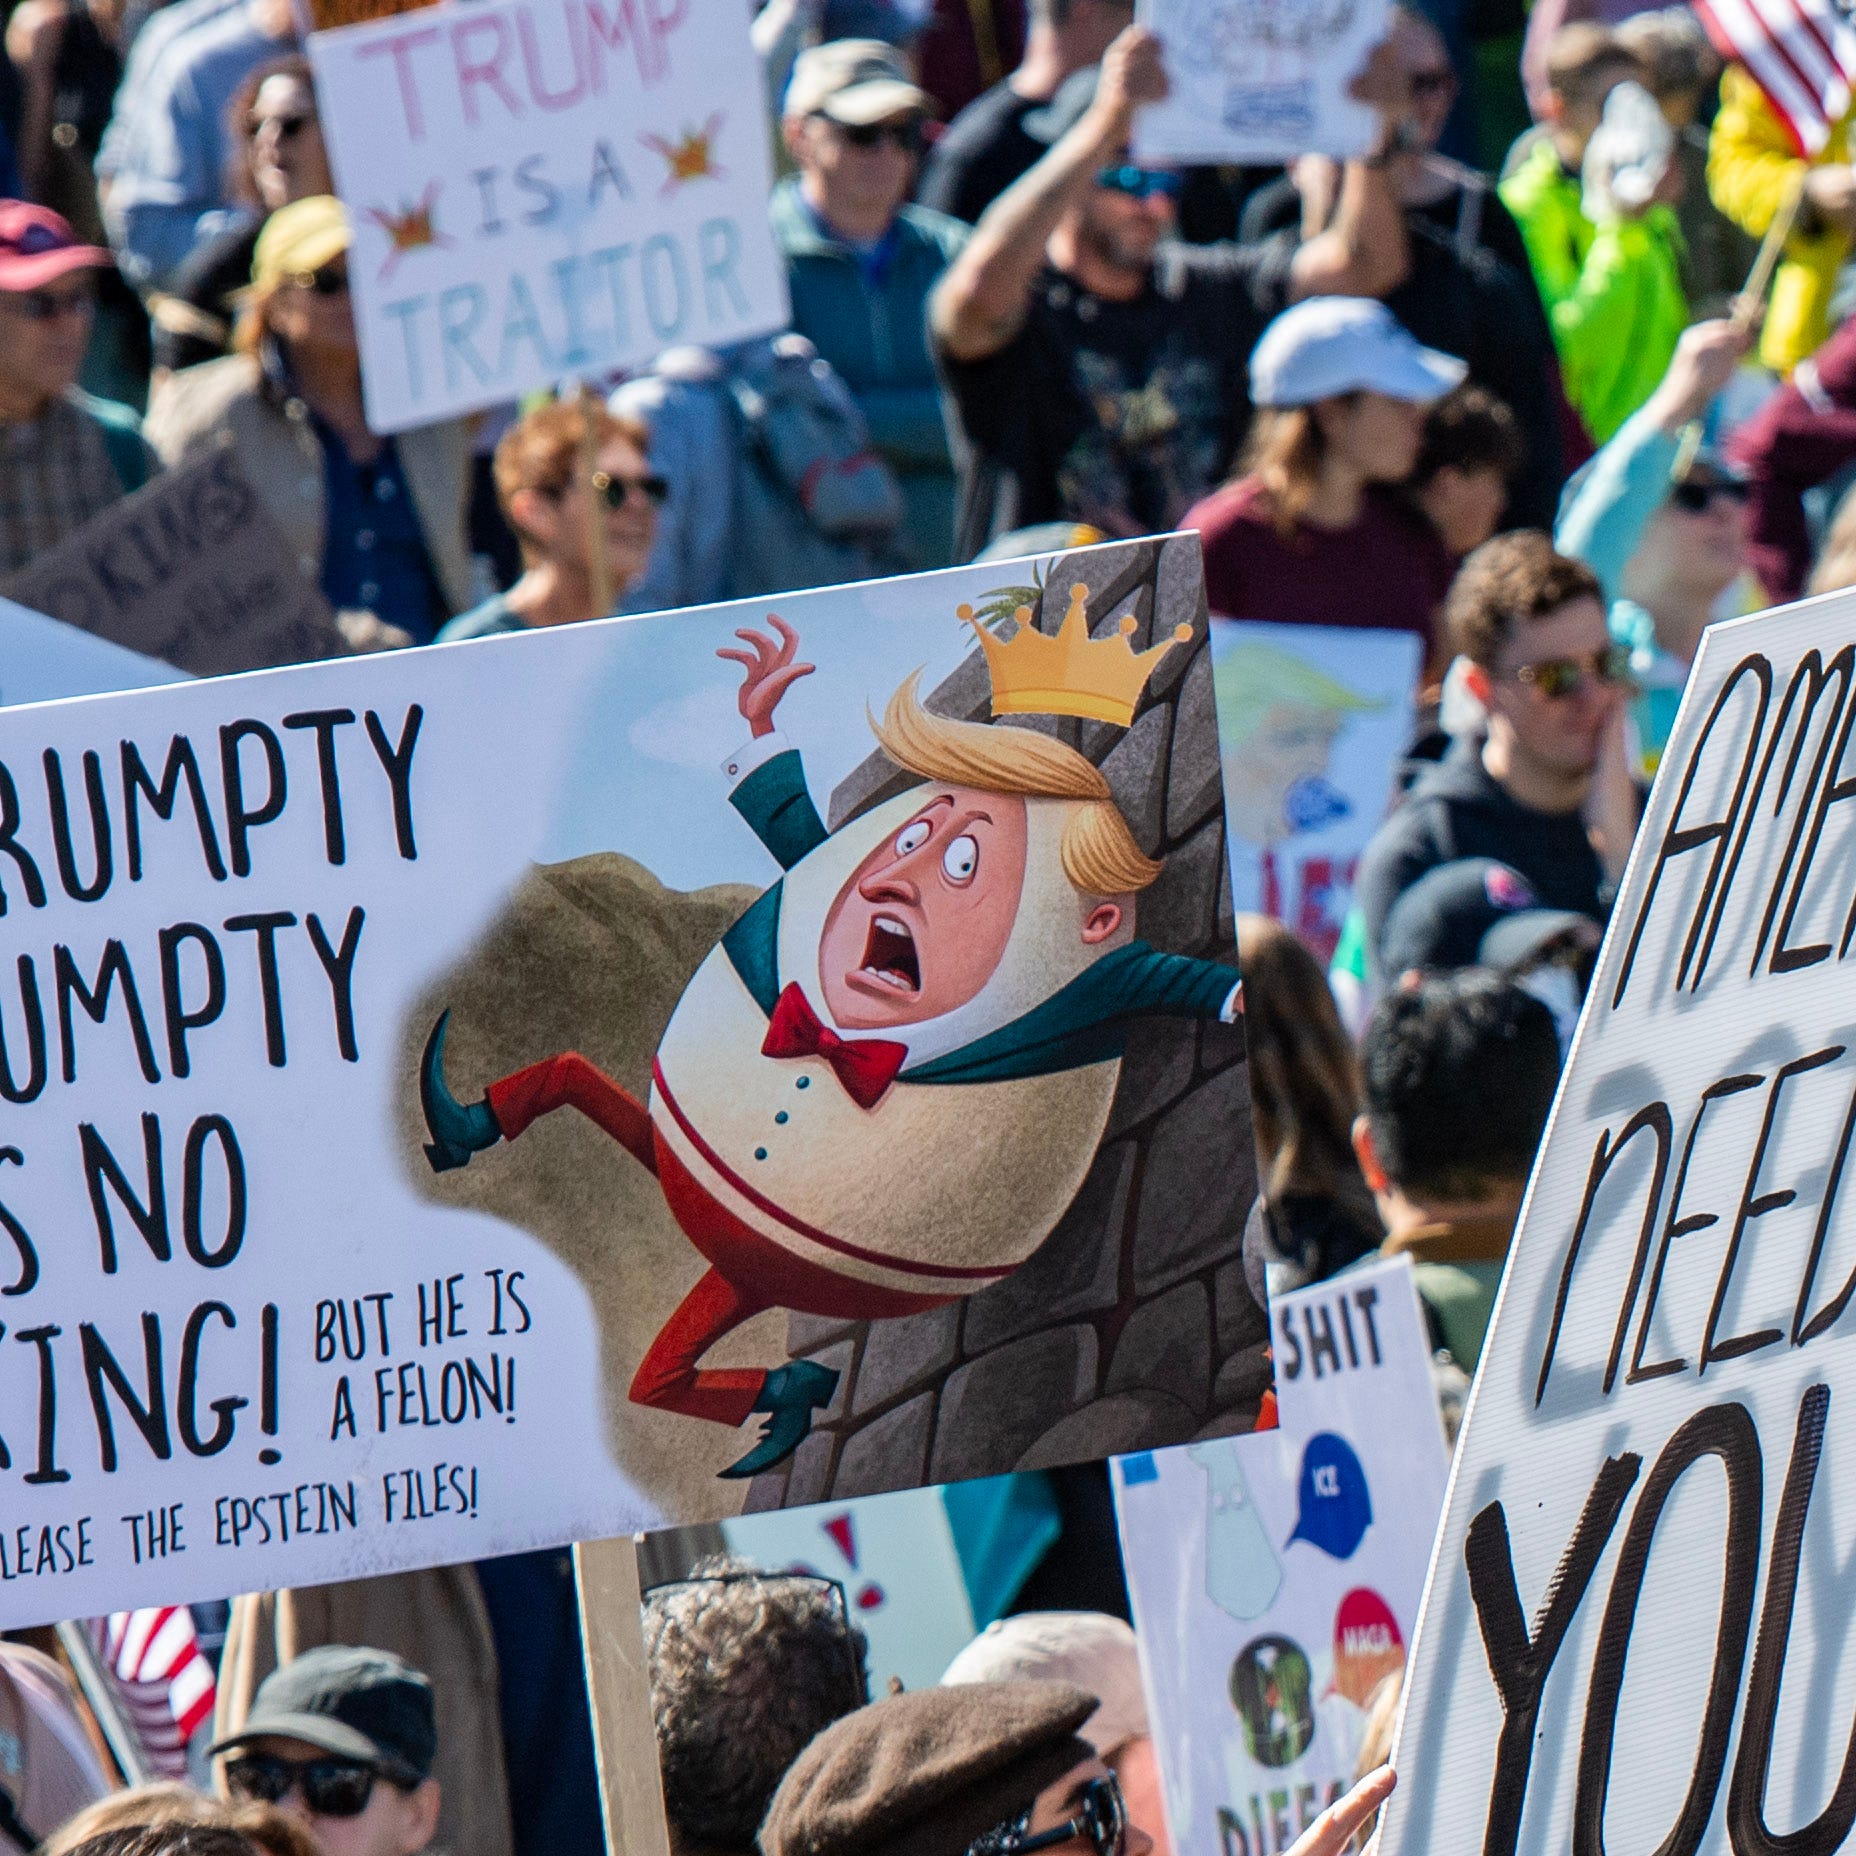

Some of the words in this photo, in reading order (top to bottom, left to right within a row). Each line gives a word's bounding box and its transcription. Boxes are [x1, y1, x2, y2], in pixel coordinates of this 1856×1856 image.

[354, 0, 692, 145] TRUMP
[474, 155, 560, 238] IS
[590, 138, 632, 200] A
[382, 216, 752, 402] TRAITOR
[78, 1112, 248, 1275] NO
[314, 1291, 394, 1363] BUT
[417, 1272, 468, 1347] HE
[484, 1268, 532, 1336] IS
[1277, 1286, 1383, 1381] SHIT
[331, 1376, 358, 1441] A
[375, 1351, 518, 1434] FELON!
[121, 1502, 187, 1565] THE
[215, 1479, 358, 1548] EPSTEIN
[383, 1462, 479, 1526] FILES!
